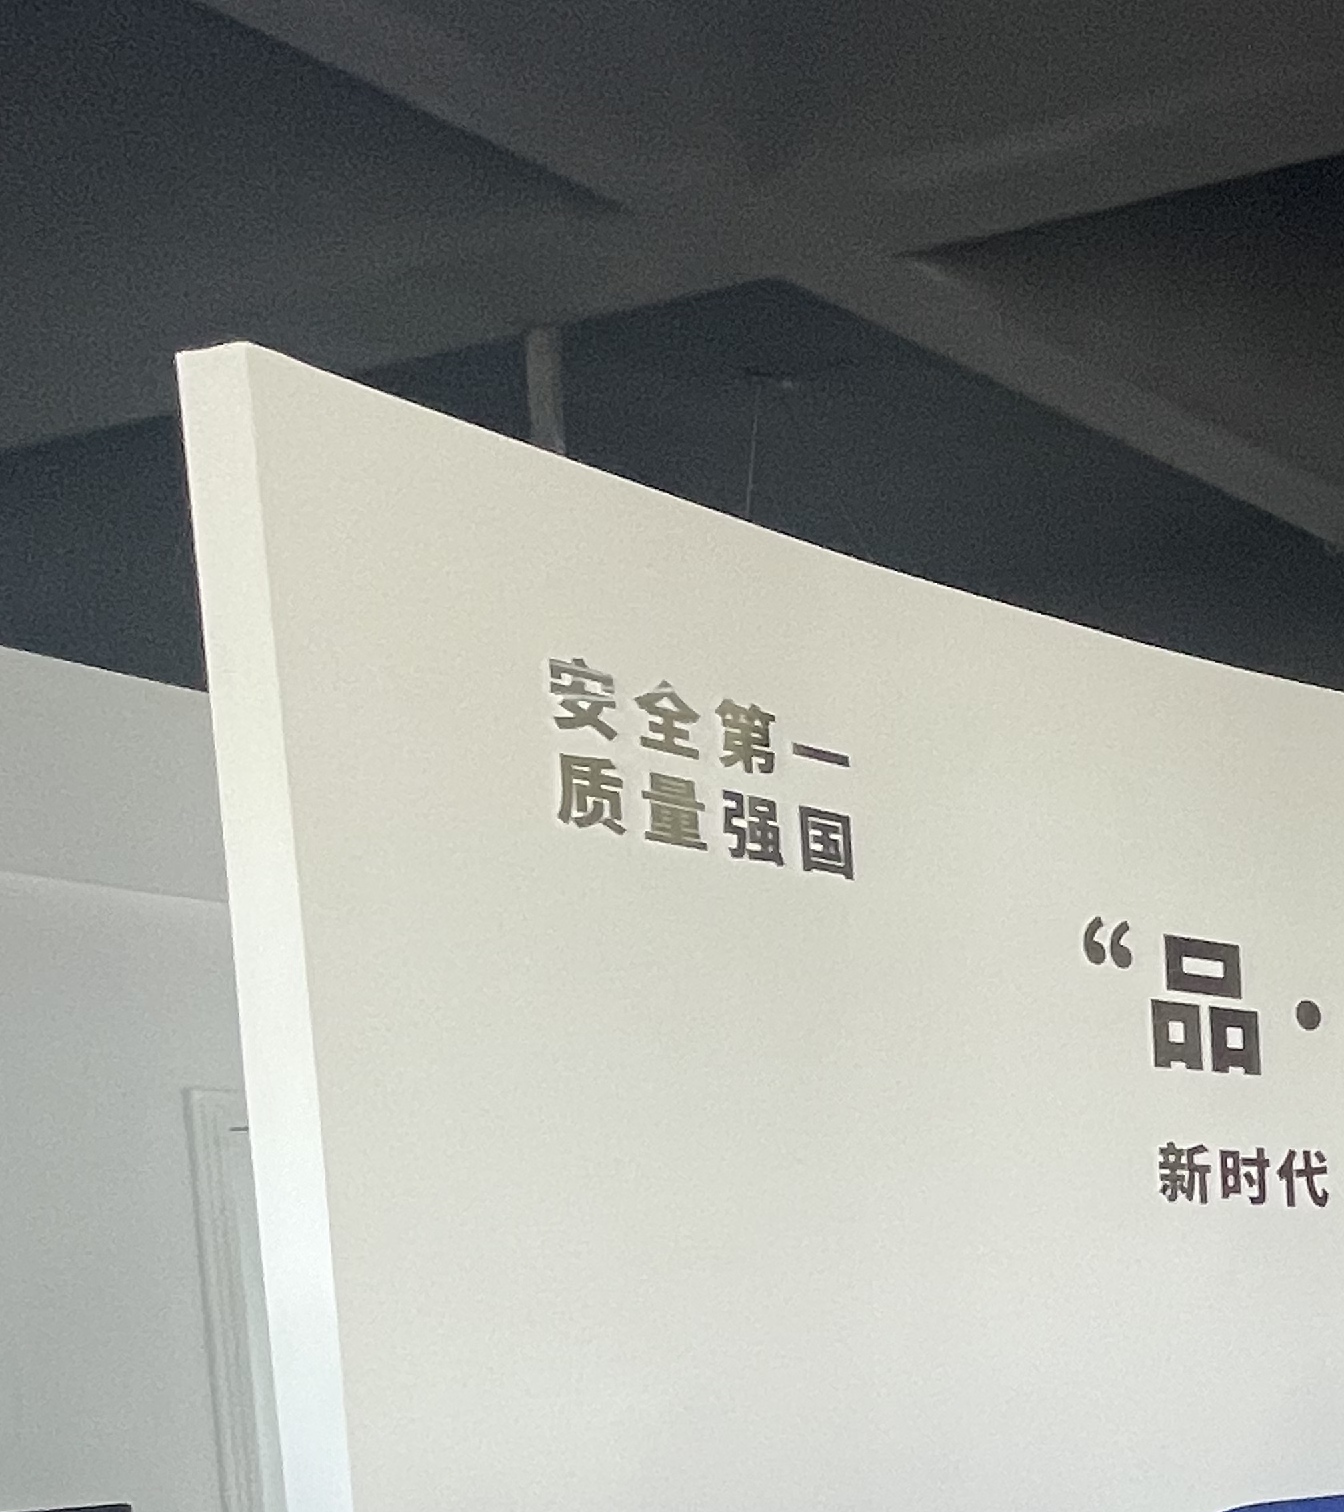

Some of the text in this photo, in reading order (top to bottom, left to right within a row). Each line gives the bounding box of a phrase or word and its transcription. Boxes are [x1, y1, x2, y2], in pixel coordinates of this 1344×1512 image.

[549, 657, 851, 776] 安全第一
[556, 752, 857, 881] 质量强国
[1158, 1141, 1330, 1208] 新时代
